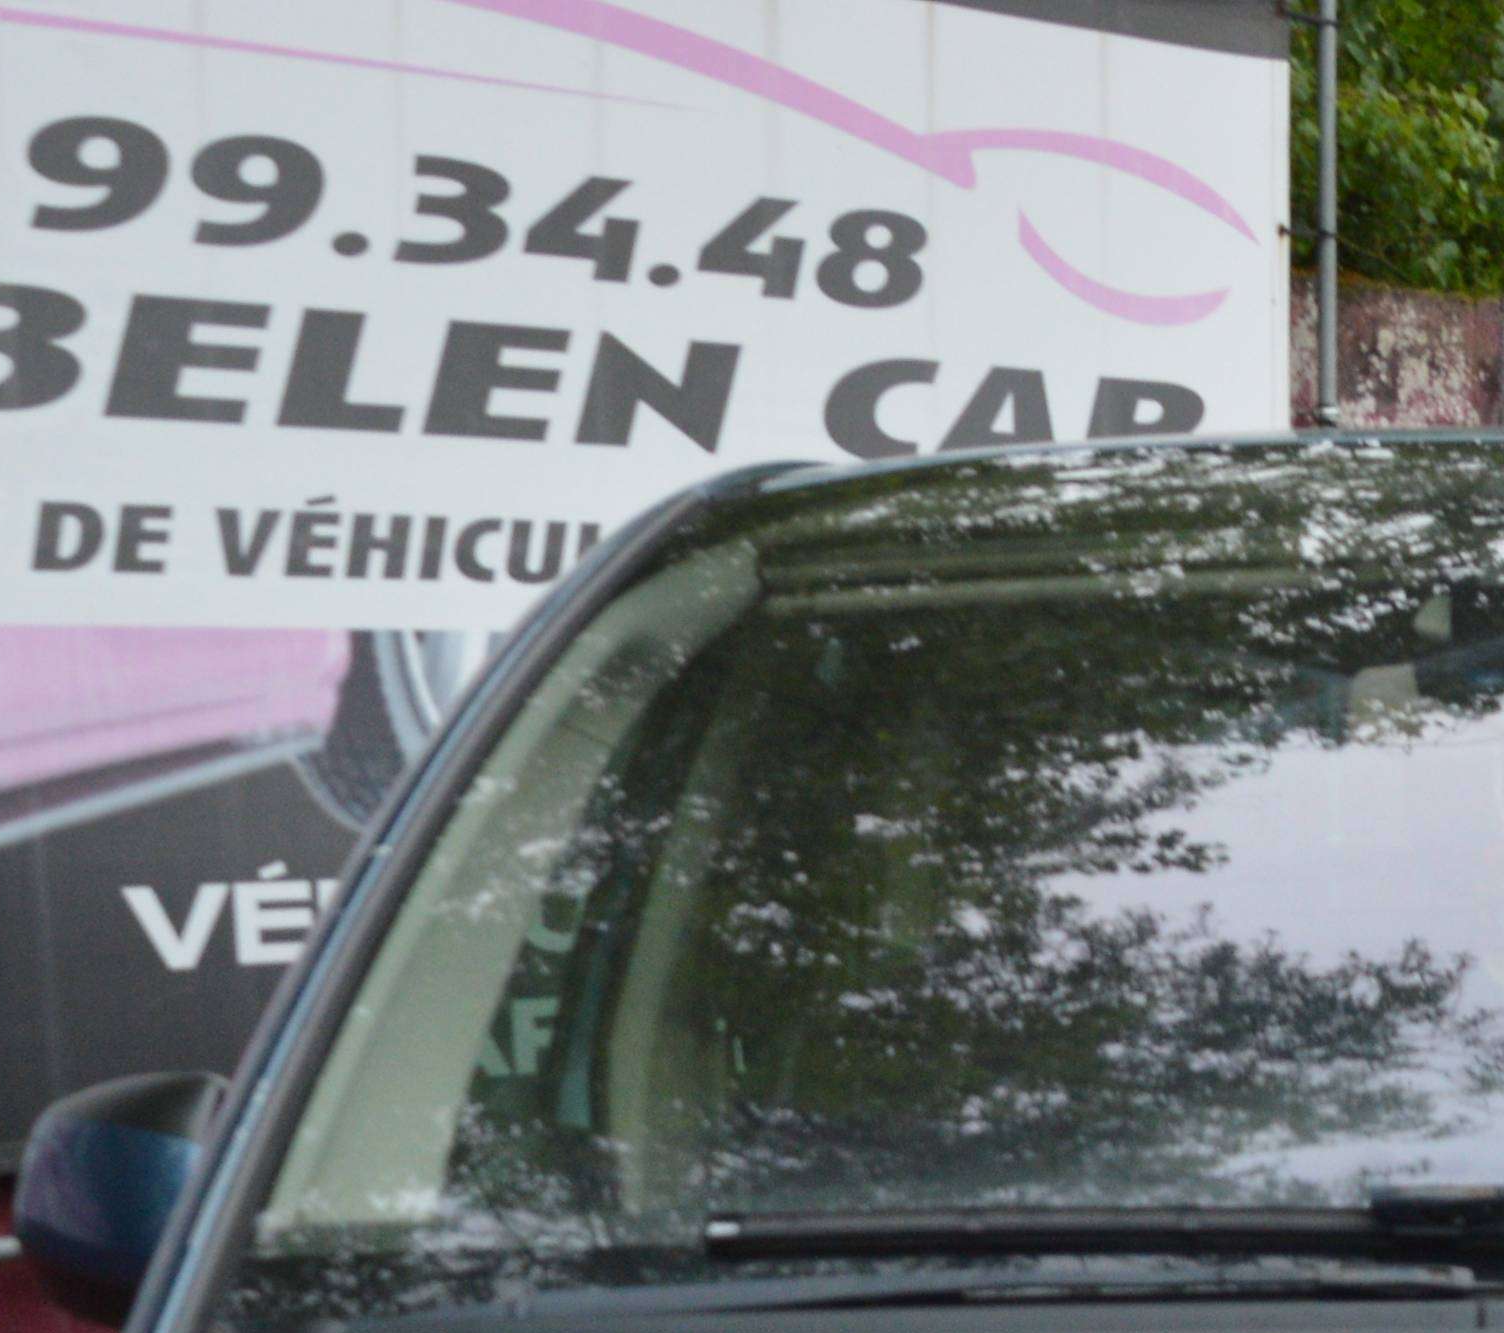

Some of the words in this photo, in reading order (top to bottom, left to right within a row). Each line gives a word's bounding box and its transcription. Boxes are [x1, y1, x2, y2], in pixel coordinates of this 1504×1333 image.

[33, 503, 172, 573] DE
[217, 497, 600, 583] VÉHICU
[121, 861, 341, 971] VÉ
